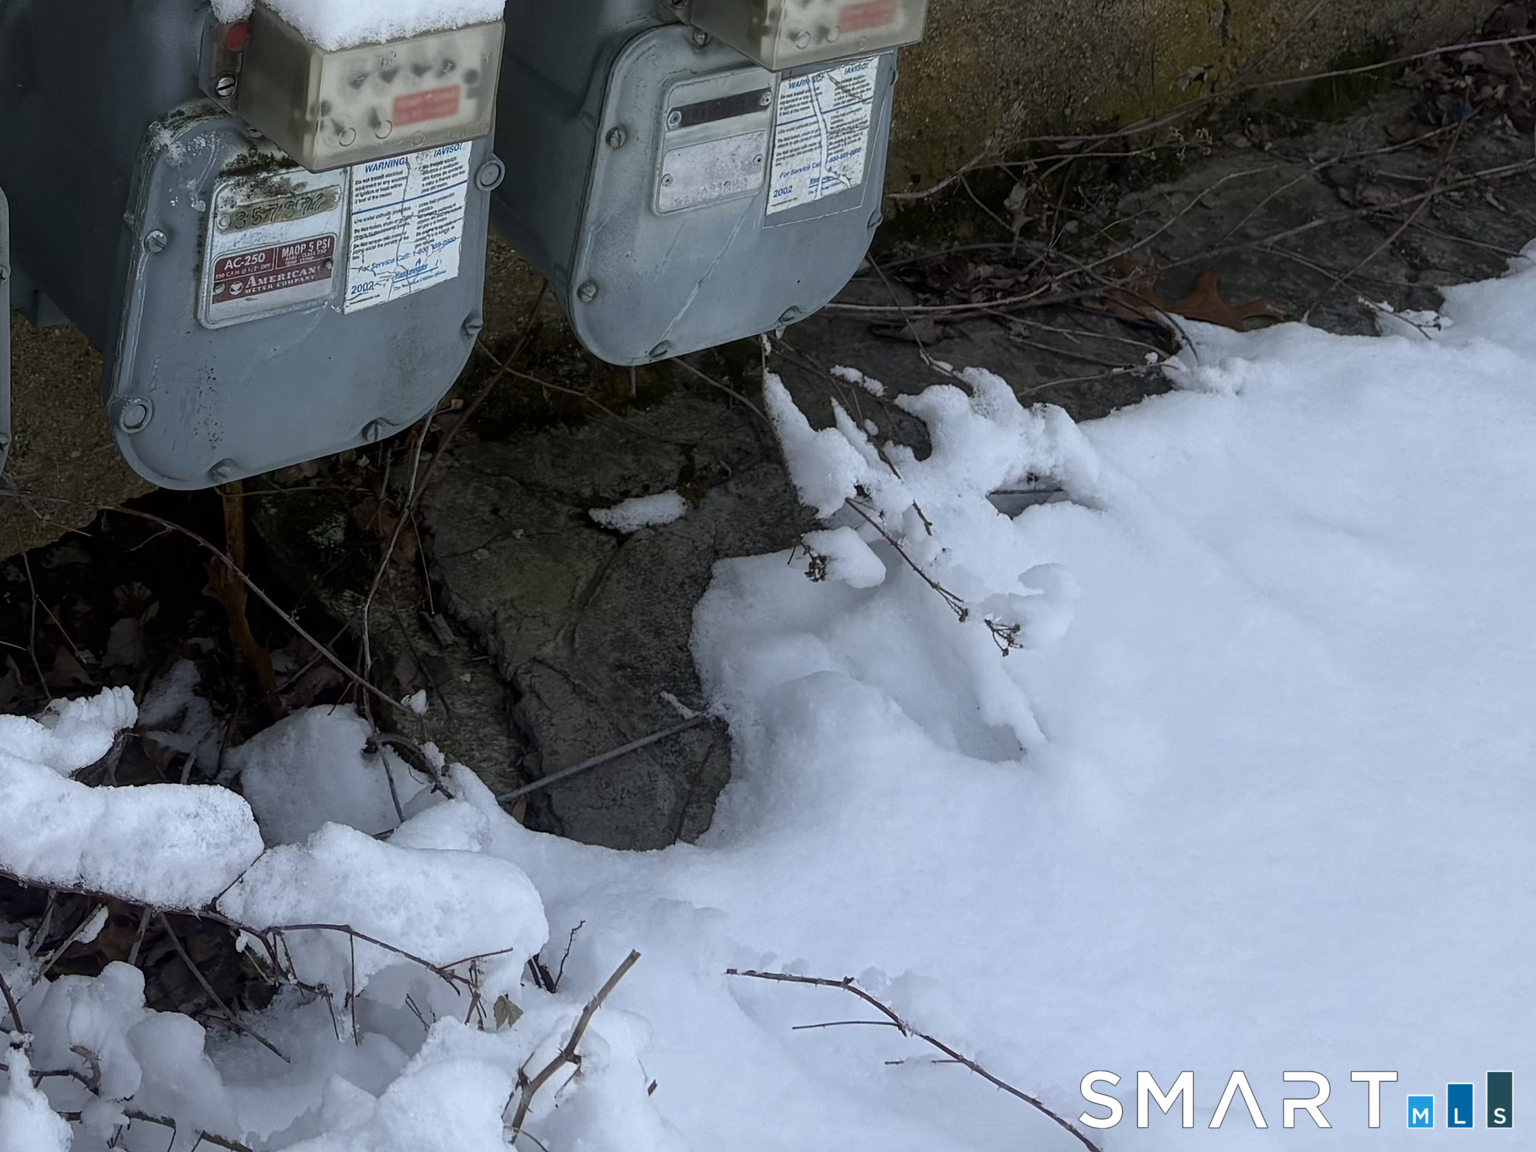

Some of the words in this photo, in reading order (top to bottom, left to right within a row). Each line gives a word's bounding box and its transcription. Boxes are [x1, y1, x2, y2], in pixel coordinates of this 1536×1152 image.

[282, 244, 306, 258] MAOP
[309, 242, 314, 252] 5
[316, 238, 330, 249] PSI
[224, 252, 266, 270] AC-250
